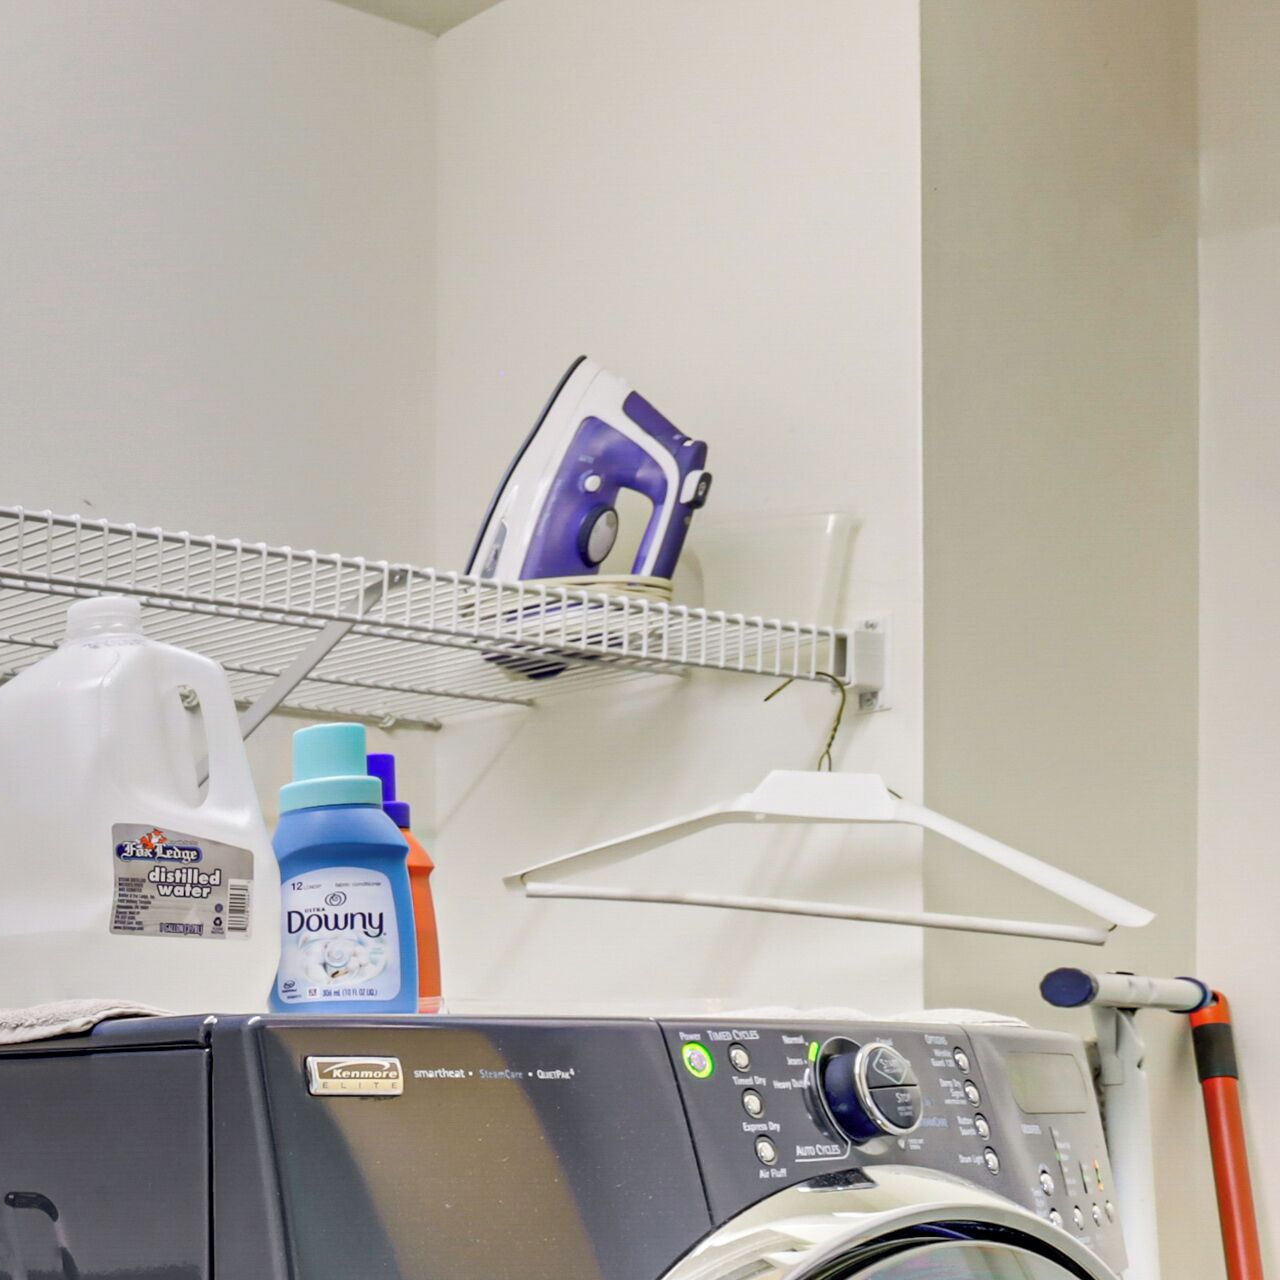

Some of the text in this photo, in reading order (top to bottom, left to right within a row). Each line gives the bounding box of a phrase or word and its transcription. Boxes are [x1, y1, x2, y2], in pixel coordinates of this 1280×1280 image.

[121, 841, 198, 864] Fox Ledge
[148, 866, 221, 886] distilled
[157, 883, 211, 898] water
[291, 882, 303, 891] 12
[287, 910, 383, 938] Downy
[332, 1067, 398, 1079] Kenmore
[413, 1068, 465, 1078] smartheat
[322, 1081, 398, 1089] ELITE
[742, 1122, 781, 1133] Express Dry
[759, 1170, 769, 1178] Air
